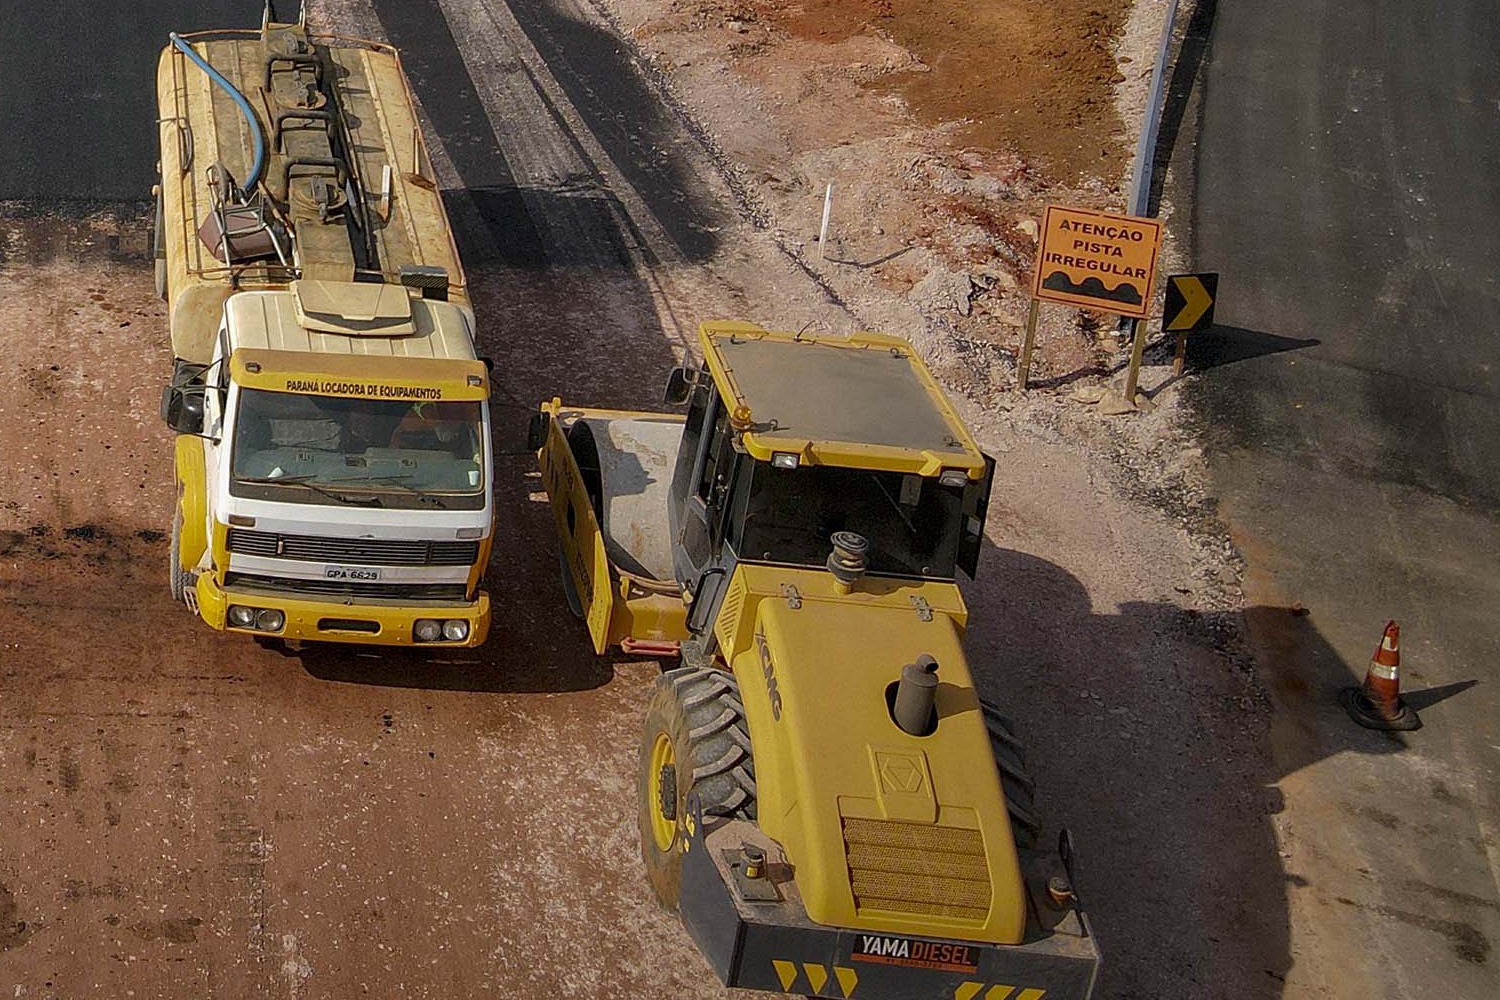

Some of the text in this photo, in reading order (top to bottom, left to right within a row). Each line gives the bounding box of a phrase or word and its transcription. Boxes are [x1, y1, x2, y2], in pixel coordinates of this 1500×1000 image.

[1059, 219, 1143, 242] ATENÇÃO
[1073, 240, 1123, 258] PISTA
[1045, 252, 1147, 279] IRREGULAR
[286, 378, 442, 399] PARANÁ LOCADORA DE EQUIPAMENTOS
